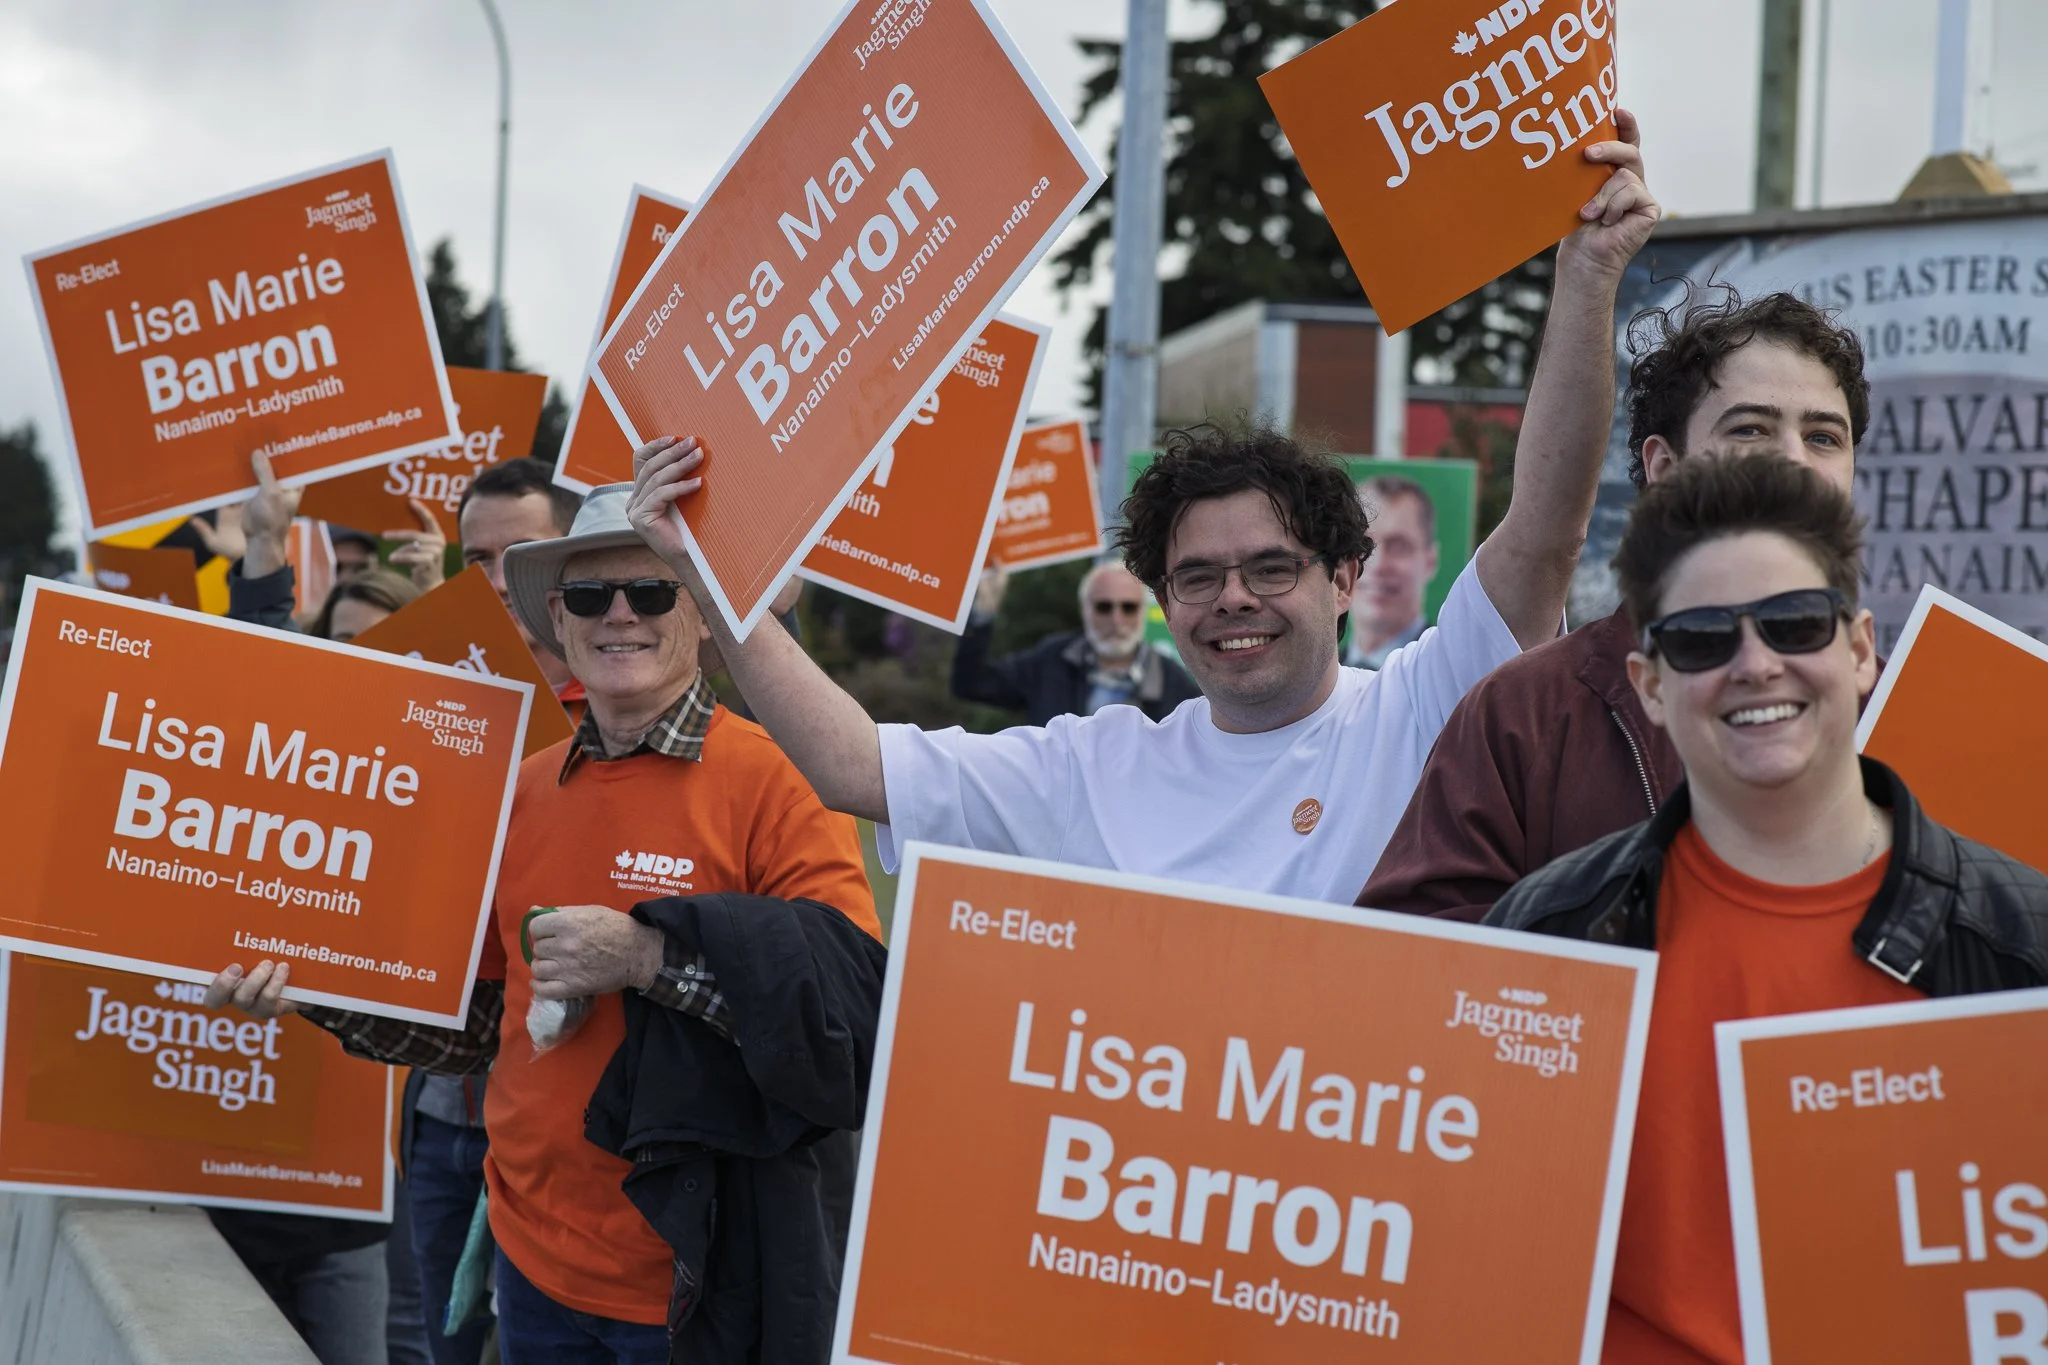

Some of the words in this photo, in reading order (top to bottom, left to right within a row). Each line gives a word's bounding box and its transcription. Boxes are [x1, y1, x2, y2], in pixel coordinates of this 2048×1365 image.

[852, 0, 914, 71] Jagme
[305, 191, 373, 228] Jagmeet
[333, 208, 377, 233] Singh
[682, 260, 785, 391] Lisa
[777, 83, 919, 262] Marie
[55, 259, 121, 291] Re-Elect
[734, 167, 940, 426] Barron
[892, 176, 1050, 371] LisaMarieBarron.ndp.ca
[1863, 255, 2020, 305] EASTER
[105, 299, 201, 354] Lisa
[208, 253, 345, 325] Marie
[624, 283, 685, 371] Re-Elect
[770, 215, 957, 454] Nanaimo–Ladysmith
[1865, 315, 2031, 361] 10:30AM
[141, 324, 338, 414] Barron
[951, 355, 1000, 388] Singh
[264, 407, 422, 457] LisaMarieBarron.ndp.ca
[384, 459, 483, 512] Sing
[1855, 464, 2048, 532] HAPE
[58, 619, 152, 659] Re-Elect
[401, 700, 489, 736] Jagmeet
[441, 700, 467, 712] NDP
[97, 691, 225, 769] Lisa
[244, 721, 419, 807] Marie
[431, 728, 484, 757] Singh
[113, 768, 373, 882] Barron
[106, 846, 361, 916] Nanaimo–Ladysmith
[609, 870, 629, 880] Lisa
[630, 872, 657, 884] Marie
[658, 876, 693, 890] Barron
[633, 851, 694, 878] NDP
[949, 900, 1077, 950] Re-Elect
[233, 930, 437, 982] LisaMarieBarron.ndp.ca
[75, 987, 283, 1063] Jagmeet
[1446, 990, 1583, 1043] Jagmeet
[153, 1048, 275, 1111] Singh
[1495, 1030, 1578, 1077] Singh
[1009, 1001, 1187, 1112] Lisa
[1217, 1036, 1479, 1162] Marie
[1790, 1066, 1944, 1112] Re-Elect
[201, 1160, 362, 1187] LisaMarieBarron.ndp.ca
[1036, 1115, 1413, 1284] Barron
[1029, 1232, 1400, 1339] Nanaimo–Ladysmith
